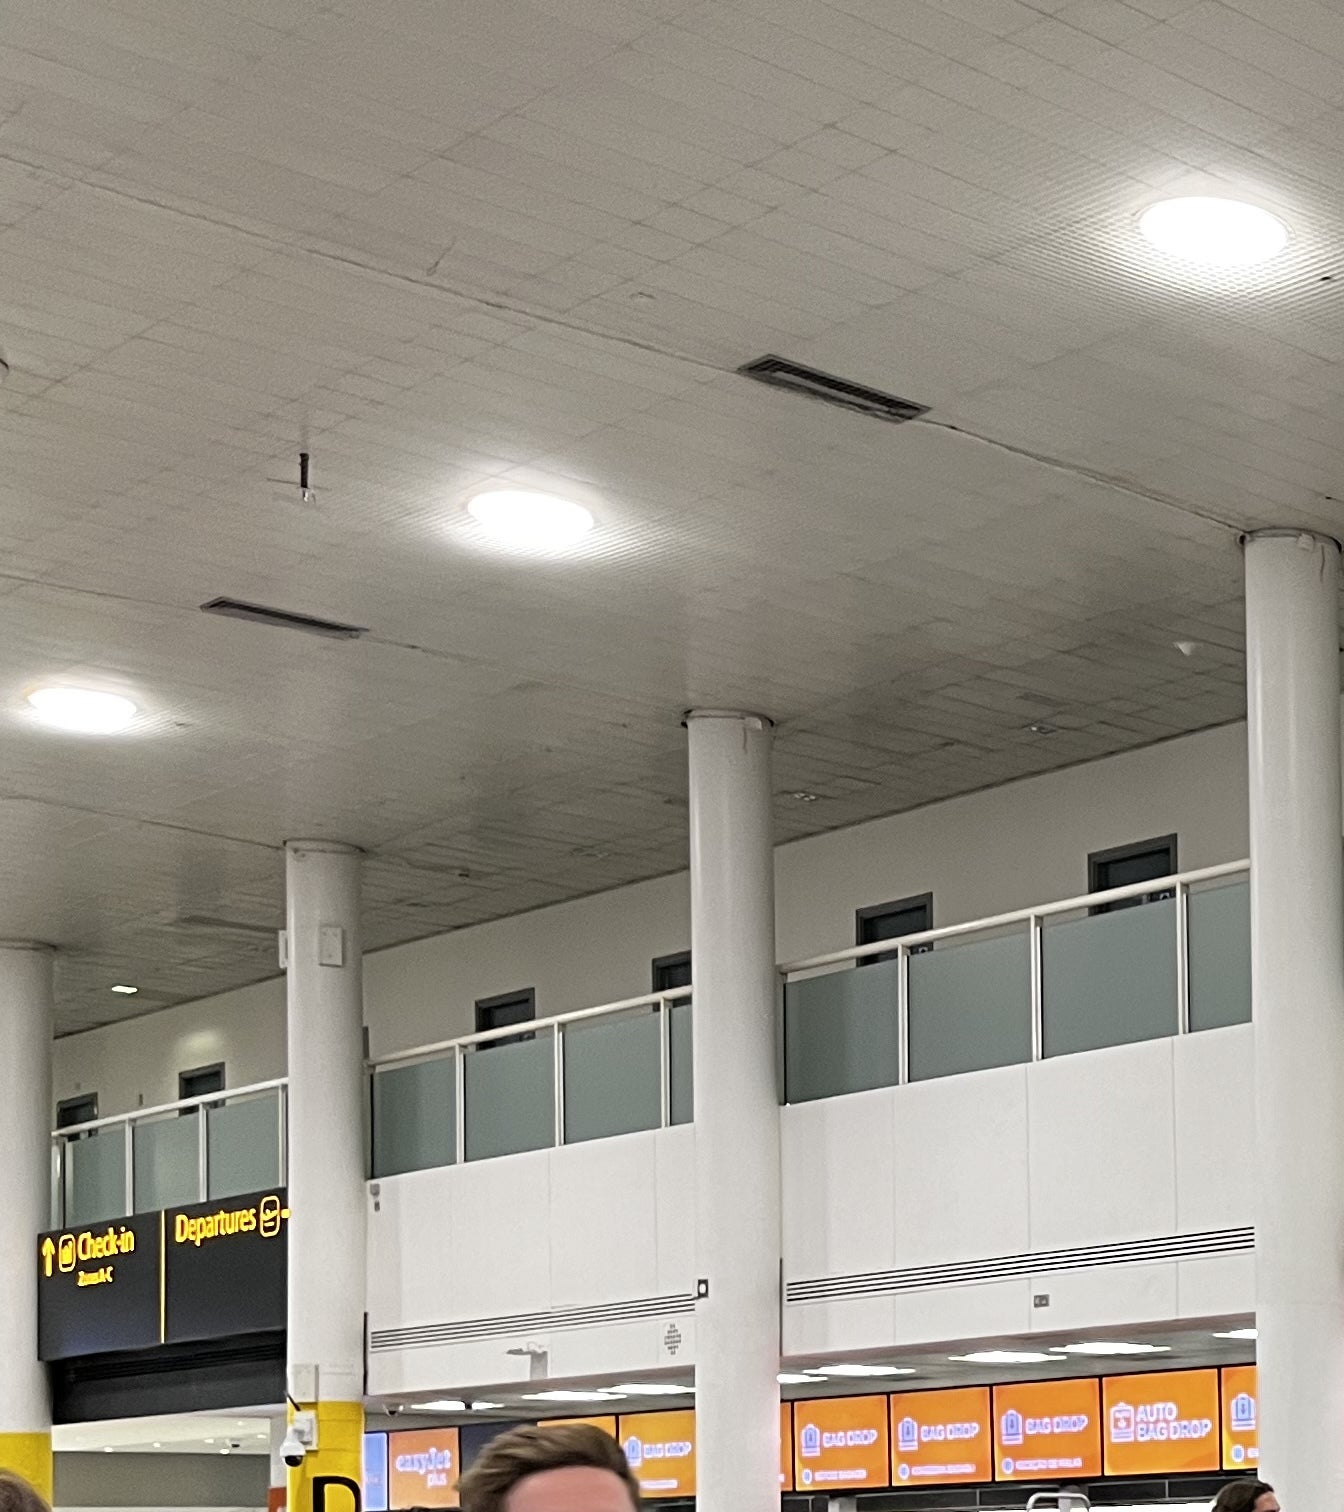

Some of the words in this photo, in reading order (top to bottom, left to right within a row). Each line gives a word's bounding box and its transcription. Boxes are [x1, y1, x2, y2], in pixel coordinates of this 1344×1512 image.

[175, 1207, 257, 1247] Departures
[77, 1225, 135, 1261] Check-in
[1136, 1402, 1176, 1423] AUTO
[1169, 1418, 1211, 1440] DROP
